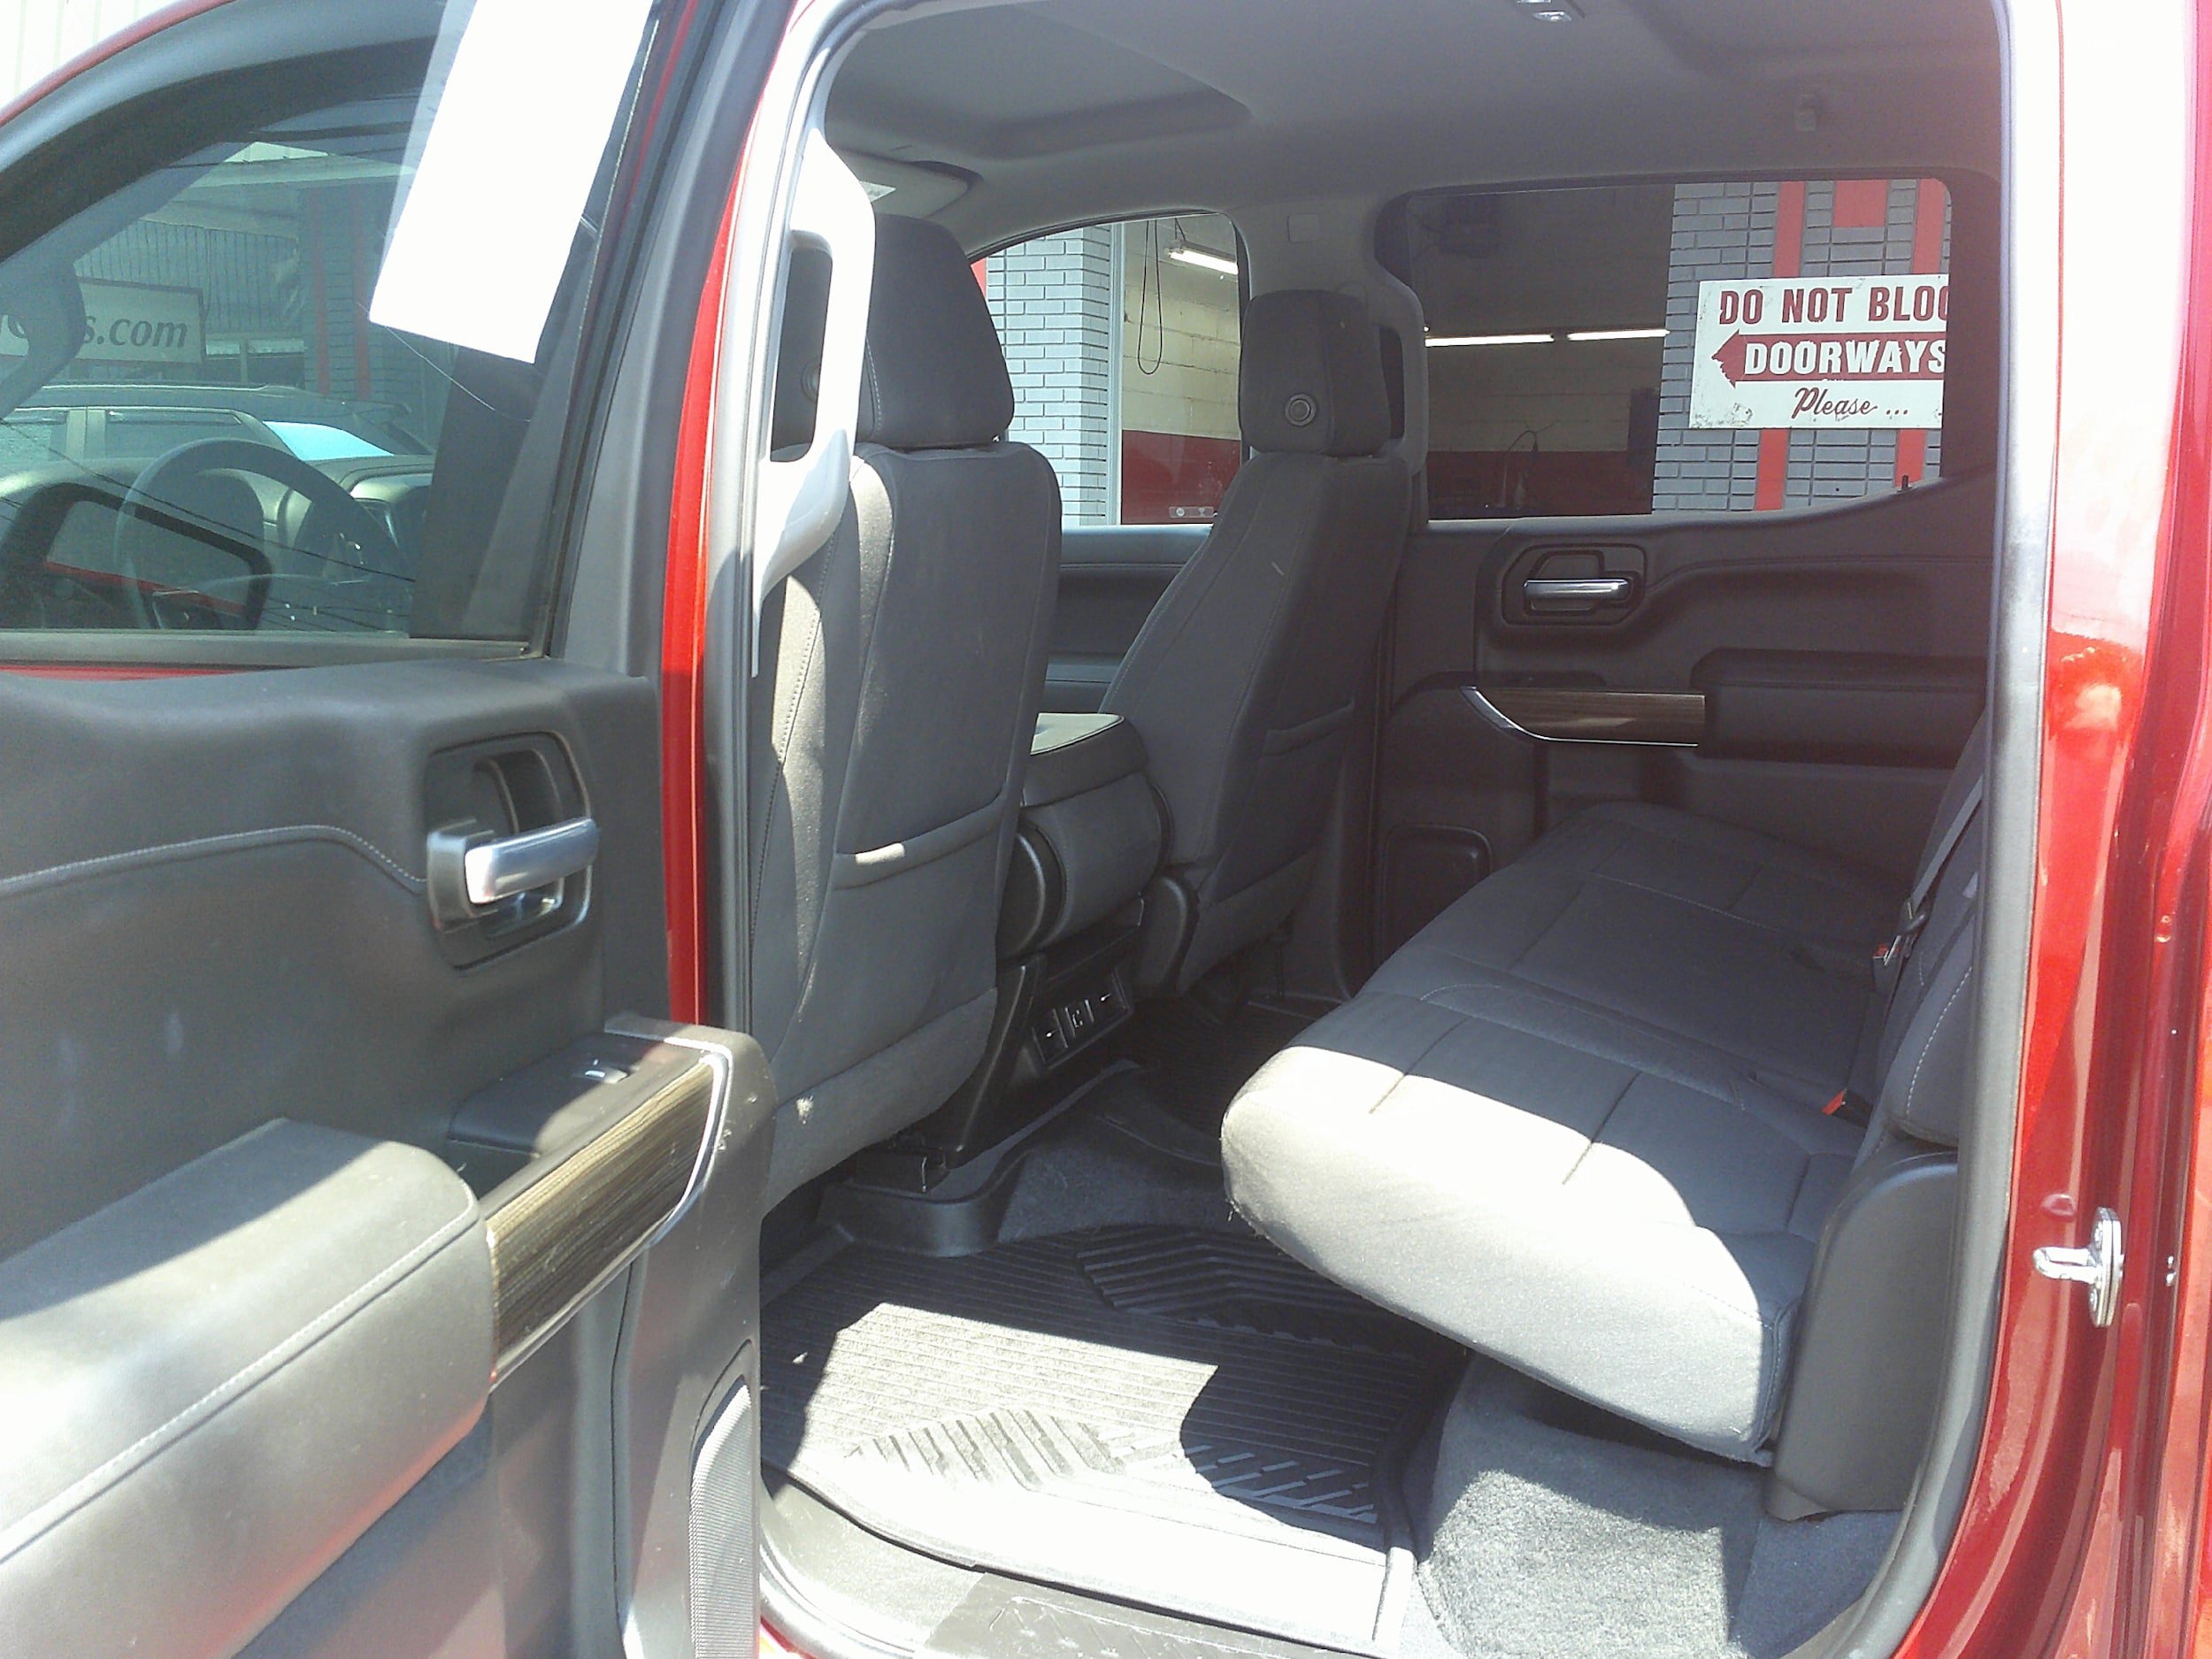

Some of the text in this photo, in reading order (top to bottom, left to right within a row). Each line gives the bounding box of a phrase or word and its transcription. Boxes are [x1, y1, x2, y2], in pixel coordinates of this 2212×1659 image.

[1719, 289, 1763, 325] DO
[1781, 288, 1853, 322] NOT
[1744, 339, 1946, 375] DOORWAYS
[1791, 387, 1878, 419] Please
